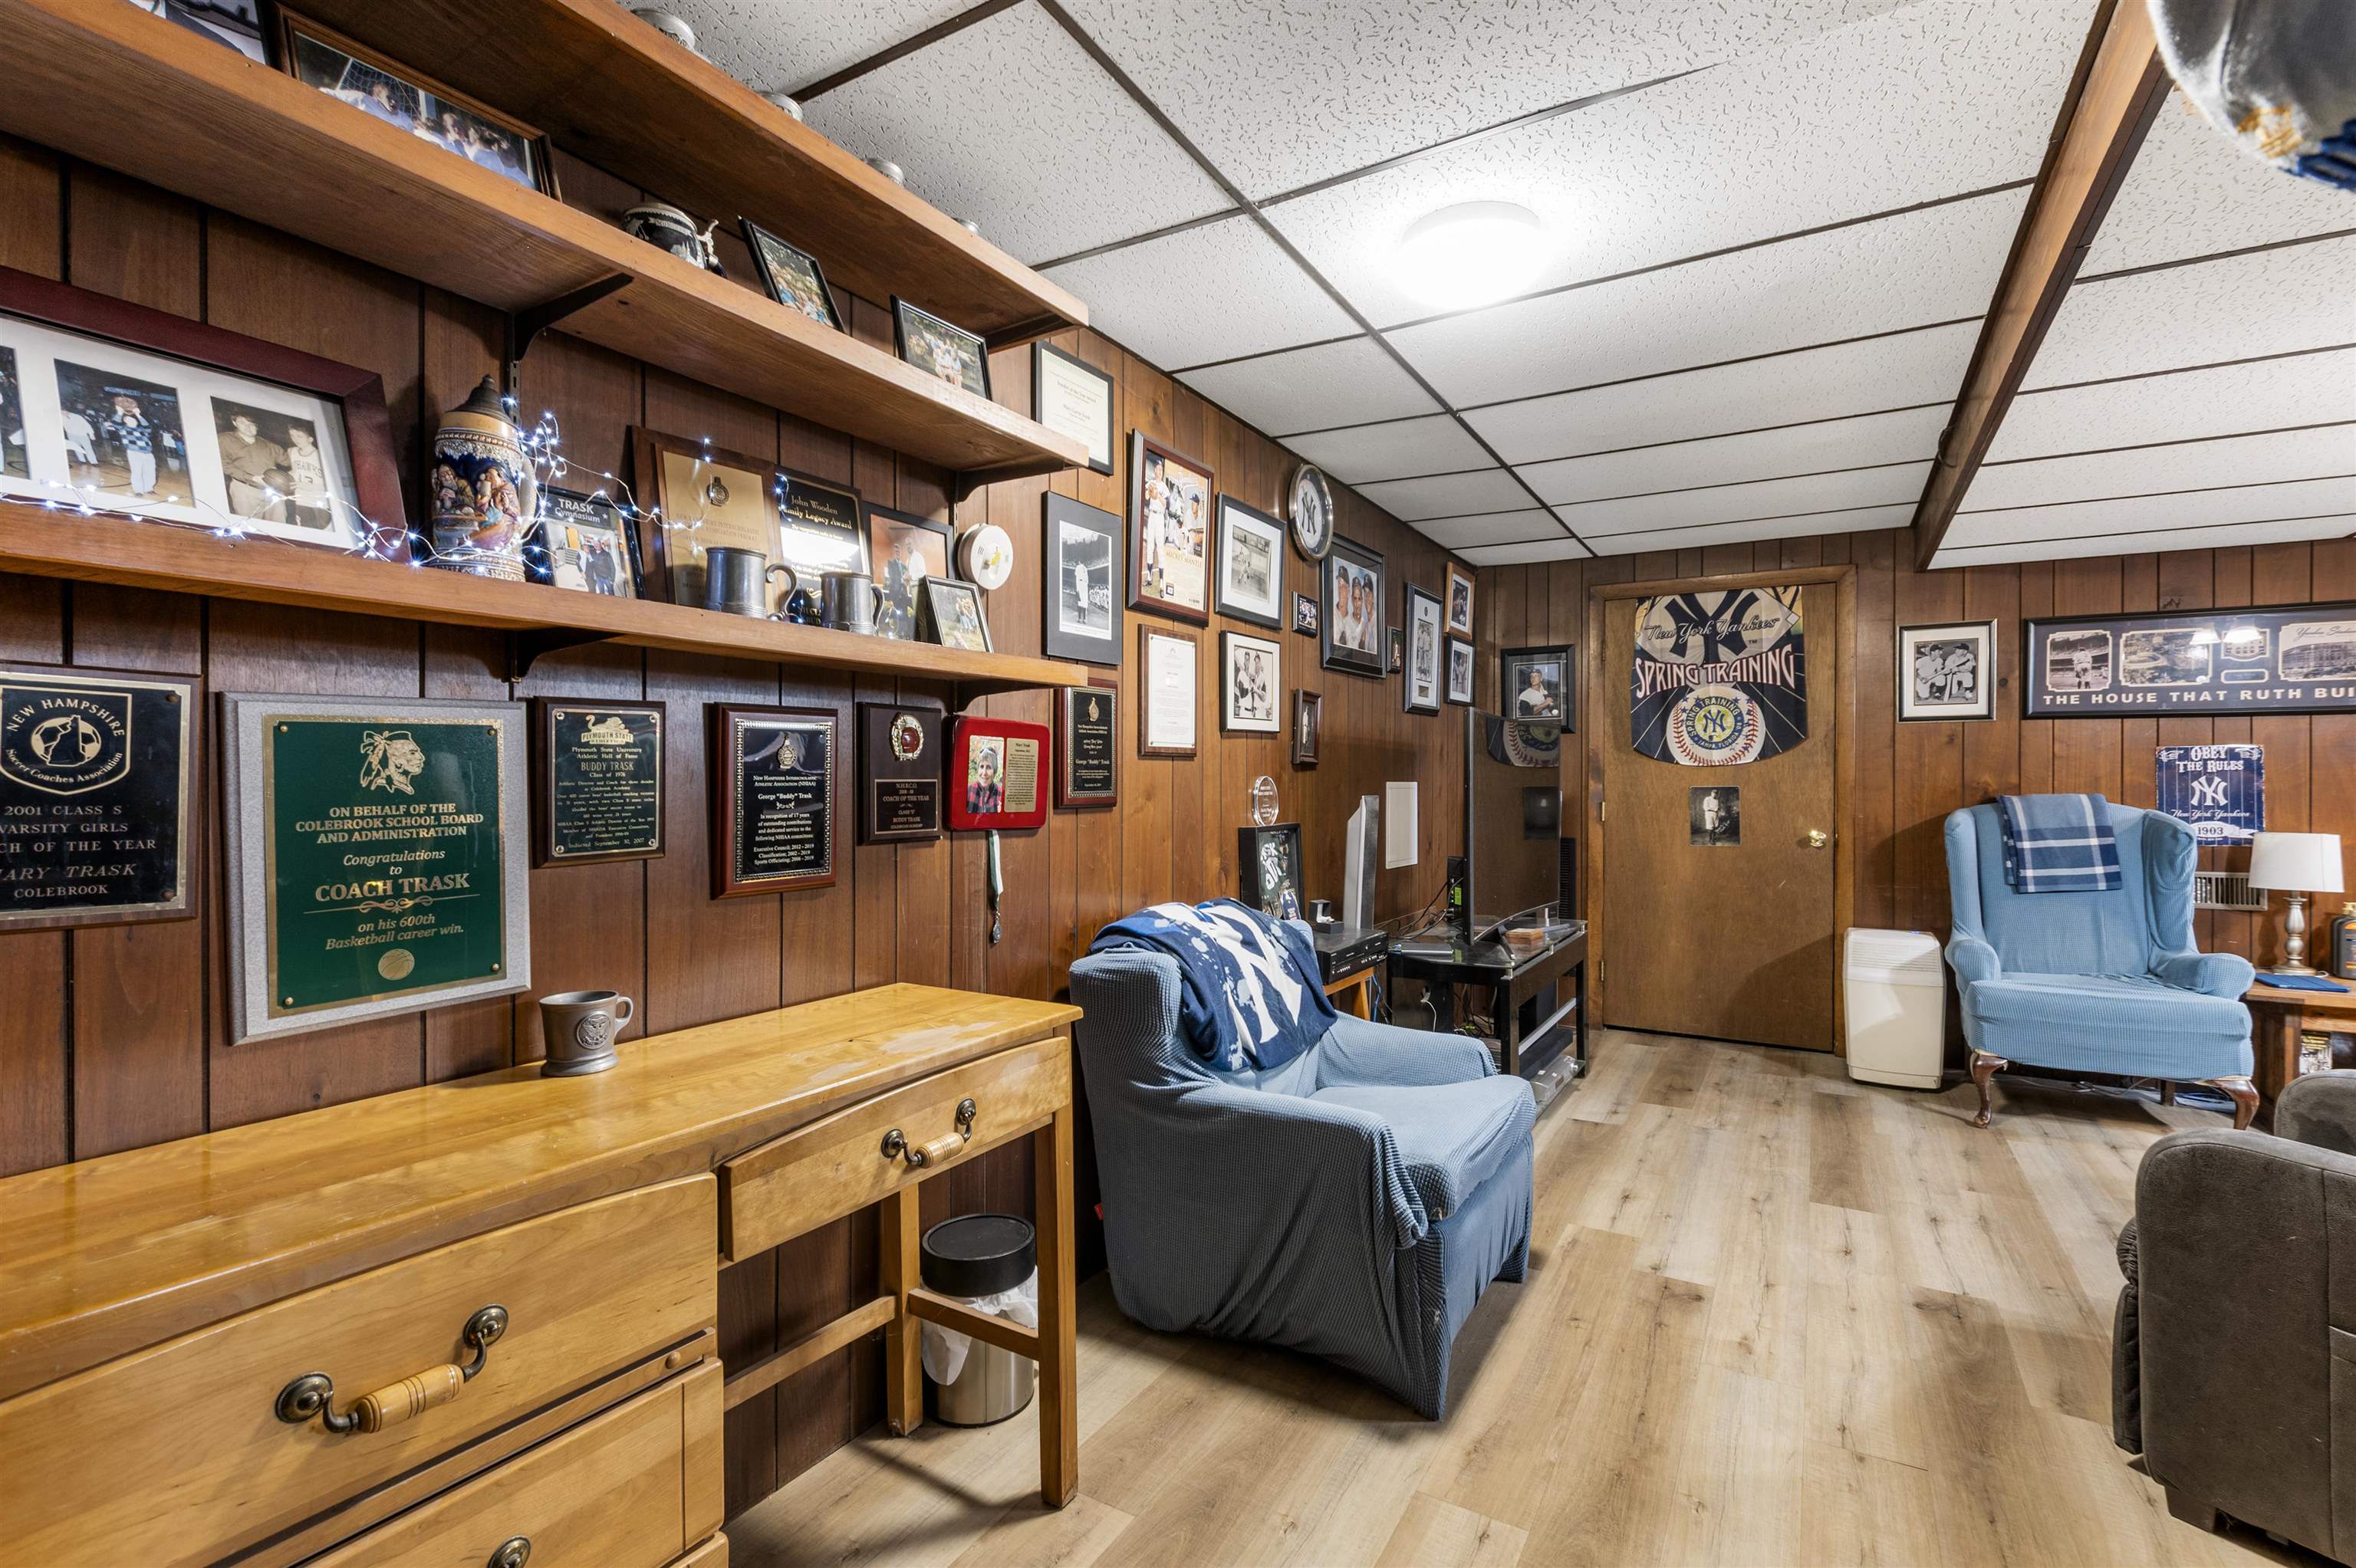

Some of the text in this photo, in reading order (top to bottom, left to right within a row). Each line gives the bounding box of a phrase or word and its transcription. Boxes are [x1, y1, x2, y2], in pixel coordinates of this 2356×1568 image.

[558, 498, 594, 514] TRASK
[791, 495, 838, 515] John Wooden
[554, 507, 601, 524] Gymnasium
[805, 510, 829, 525] Legacy
[831, 518, 852, 529] Award
[1166, 551, 1203, 569] MICKEY MANTLE
[1644, 614, 1779, 643] New York Yankees
[1635, 643, 1795, 699] SPRING TRAINING
[2043, 687, 2355, 705] THE HOUSE THAT RUTH BUI
[6, 698, 125, 737] NEW HAMPSHIRE
[1686, 697, 1740, 736] SPRING TRAINING
[1703, 709, 1726, 733] NY
[582, 731, 614, 741] PLYMOUTH
[615, 732, 633, 741] STATE
[2191, 746, 2228, 761] OBEY
[6, 748, 123, 783] Soccer Coaches Association
[581, 761, 634, 771] BUDDY TRASK
[2175, 760, 2244, 773] THE RULES
[2190, 774, 2228, 806] NY
[5, 805, 123, 816] 2001 CLASS S
[329, 803, 456, 817] ON BEHALF OF THE
[2171, 809, 2251, 820] New York Yankees
[0, 823, 129, 834] VARSITY GIRLS
[295, 814, 484, 832] COLEBROOK SCHOOL BOARD
[2198, 827, 2223, 835] 1903
[317, 826, 468, 844] AND ADMINISTRATION
[33, 842, 56, 853] OF
[66, 841, 102, 852] THE
[113, 839, 157, 850] YEAR
[343, 850, 446, 866] Congratulations
[0, 863, 137, 881] ARY TRASK
[390, 866, 403, 876] to
[14, 884, 110, 899] COLEBROOK
[315, 873, 470, 902] COACH TRASK
[357, 913, 436, 933] on his 600th
[325, 923, 464, 951] Basketball career win.
